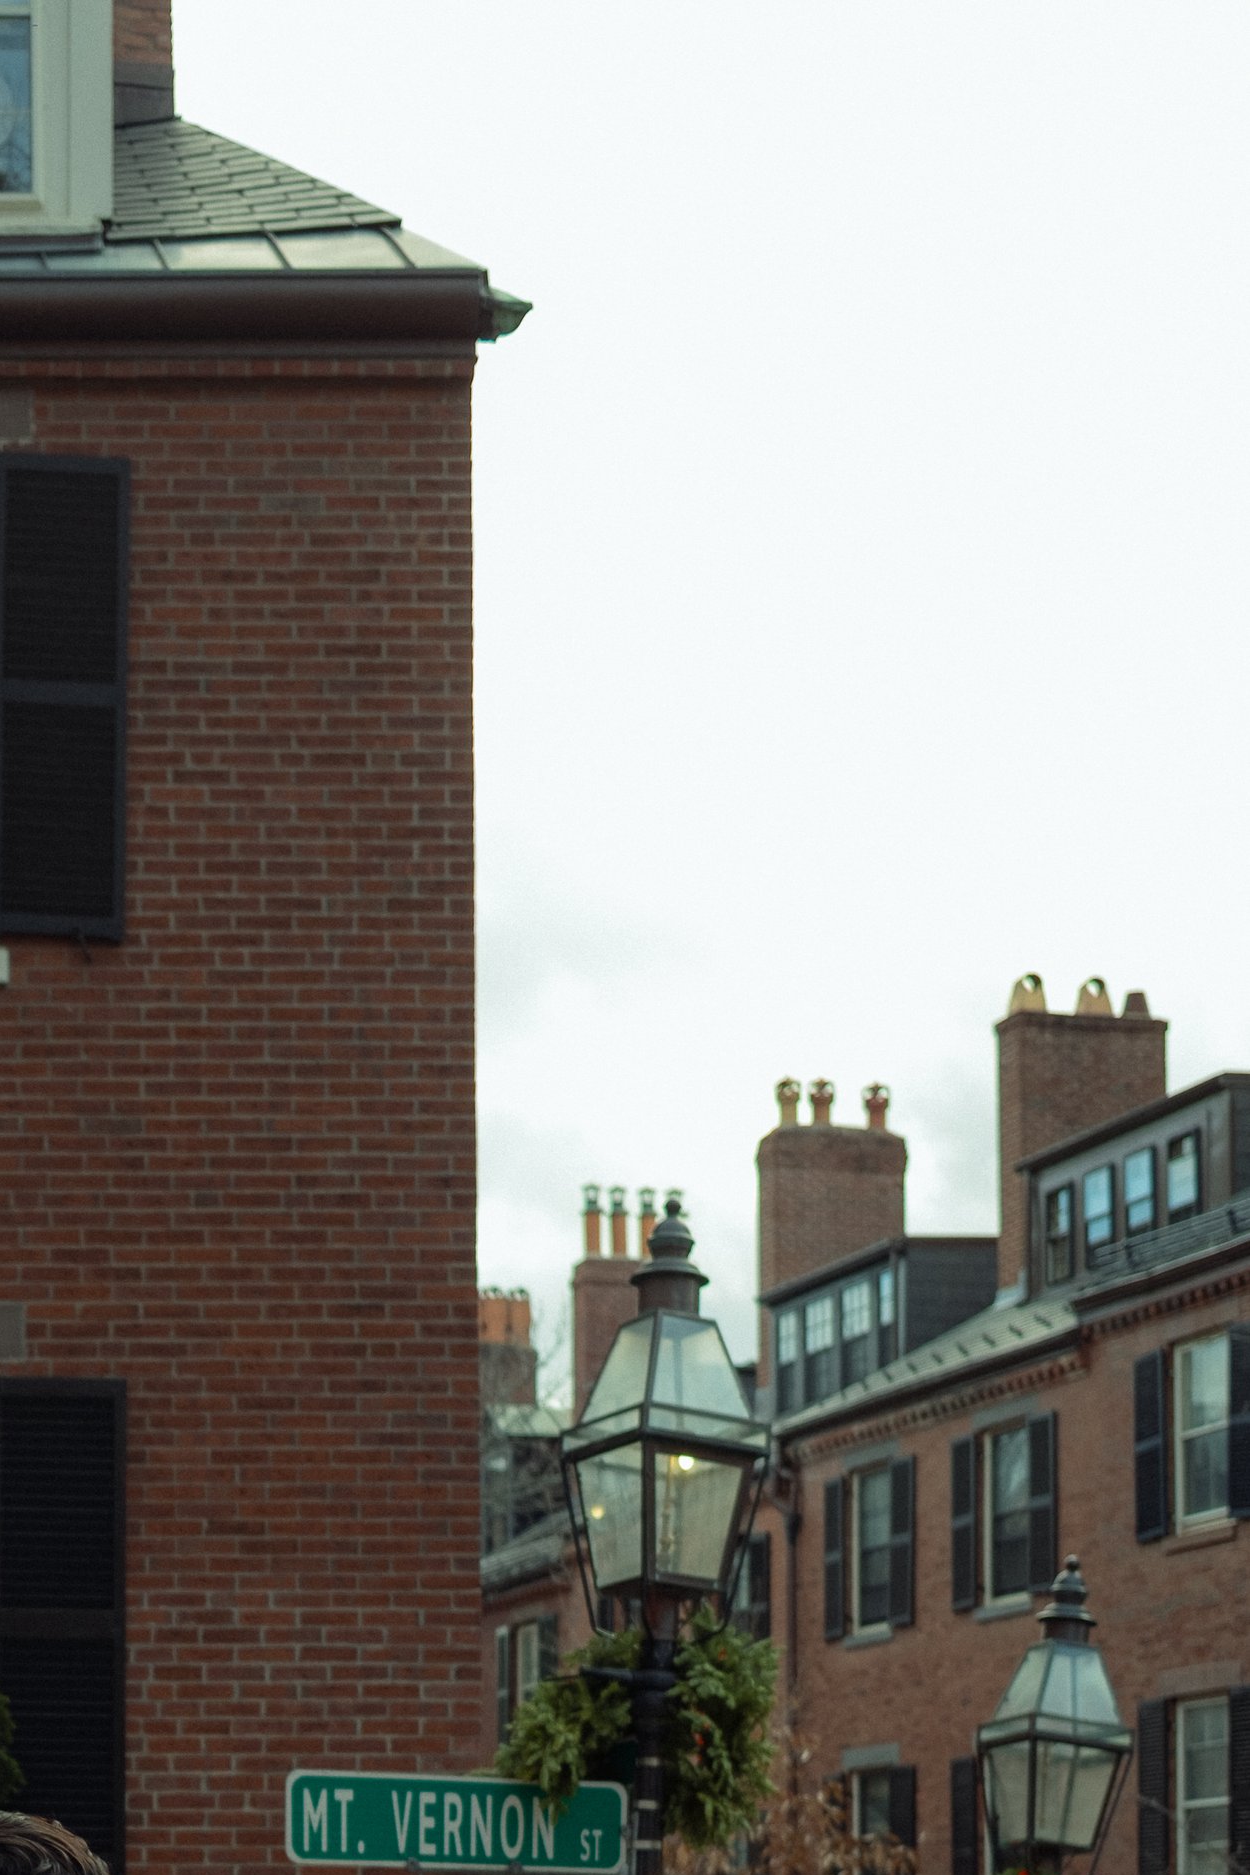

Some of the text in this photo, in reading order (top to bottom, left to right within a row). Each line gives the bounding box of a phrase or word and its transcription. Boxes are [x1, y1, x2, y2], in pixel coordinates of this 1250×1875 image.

[302, 1787, 603, 1862] MT. VERNON ST
